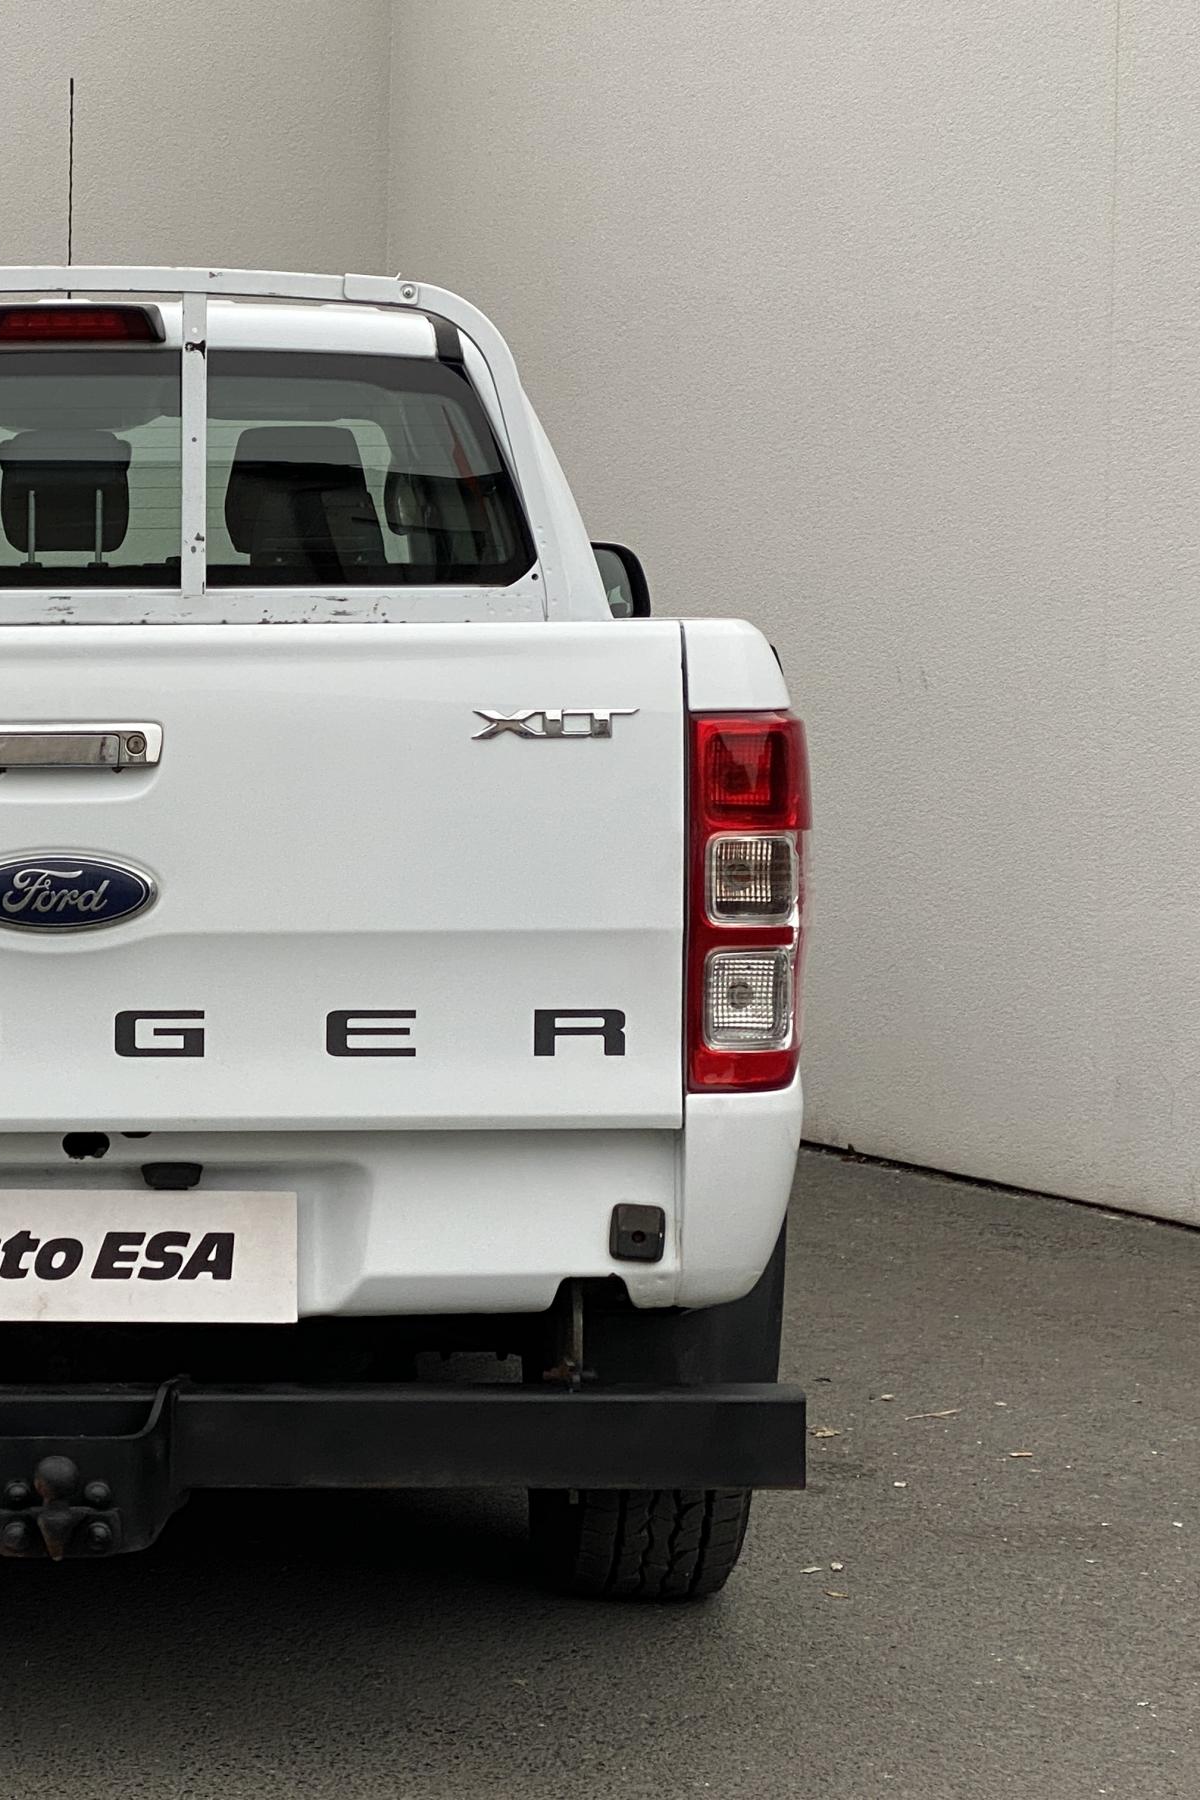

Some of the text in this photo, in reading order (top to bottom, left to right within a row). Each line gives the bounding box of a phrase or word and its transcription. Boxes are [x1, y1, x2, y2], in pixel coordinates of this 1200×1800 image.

[471, 706, 641, 741] XLT
[2, 868, 110, 913] Ford
[91, 1230, 236, 1281] ESA
